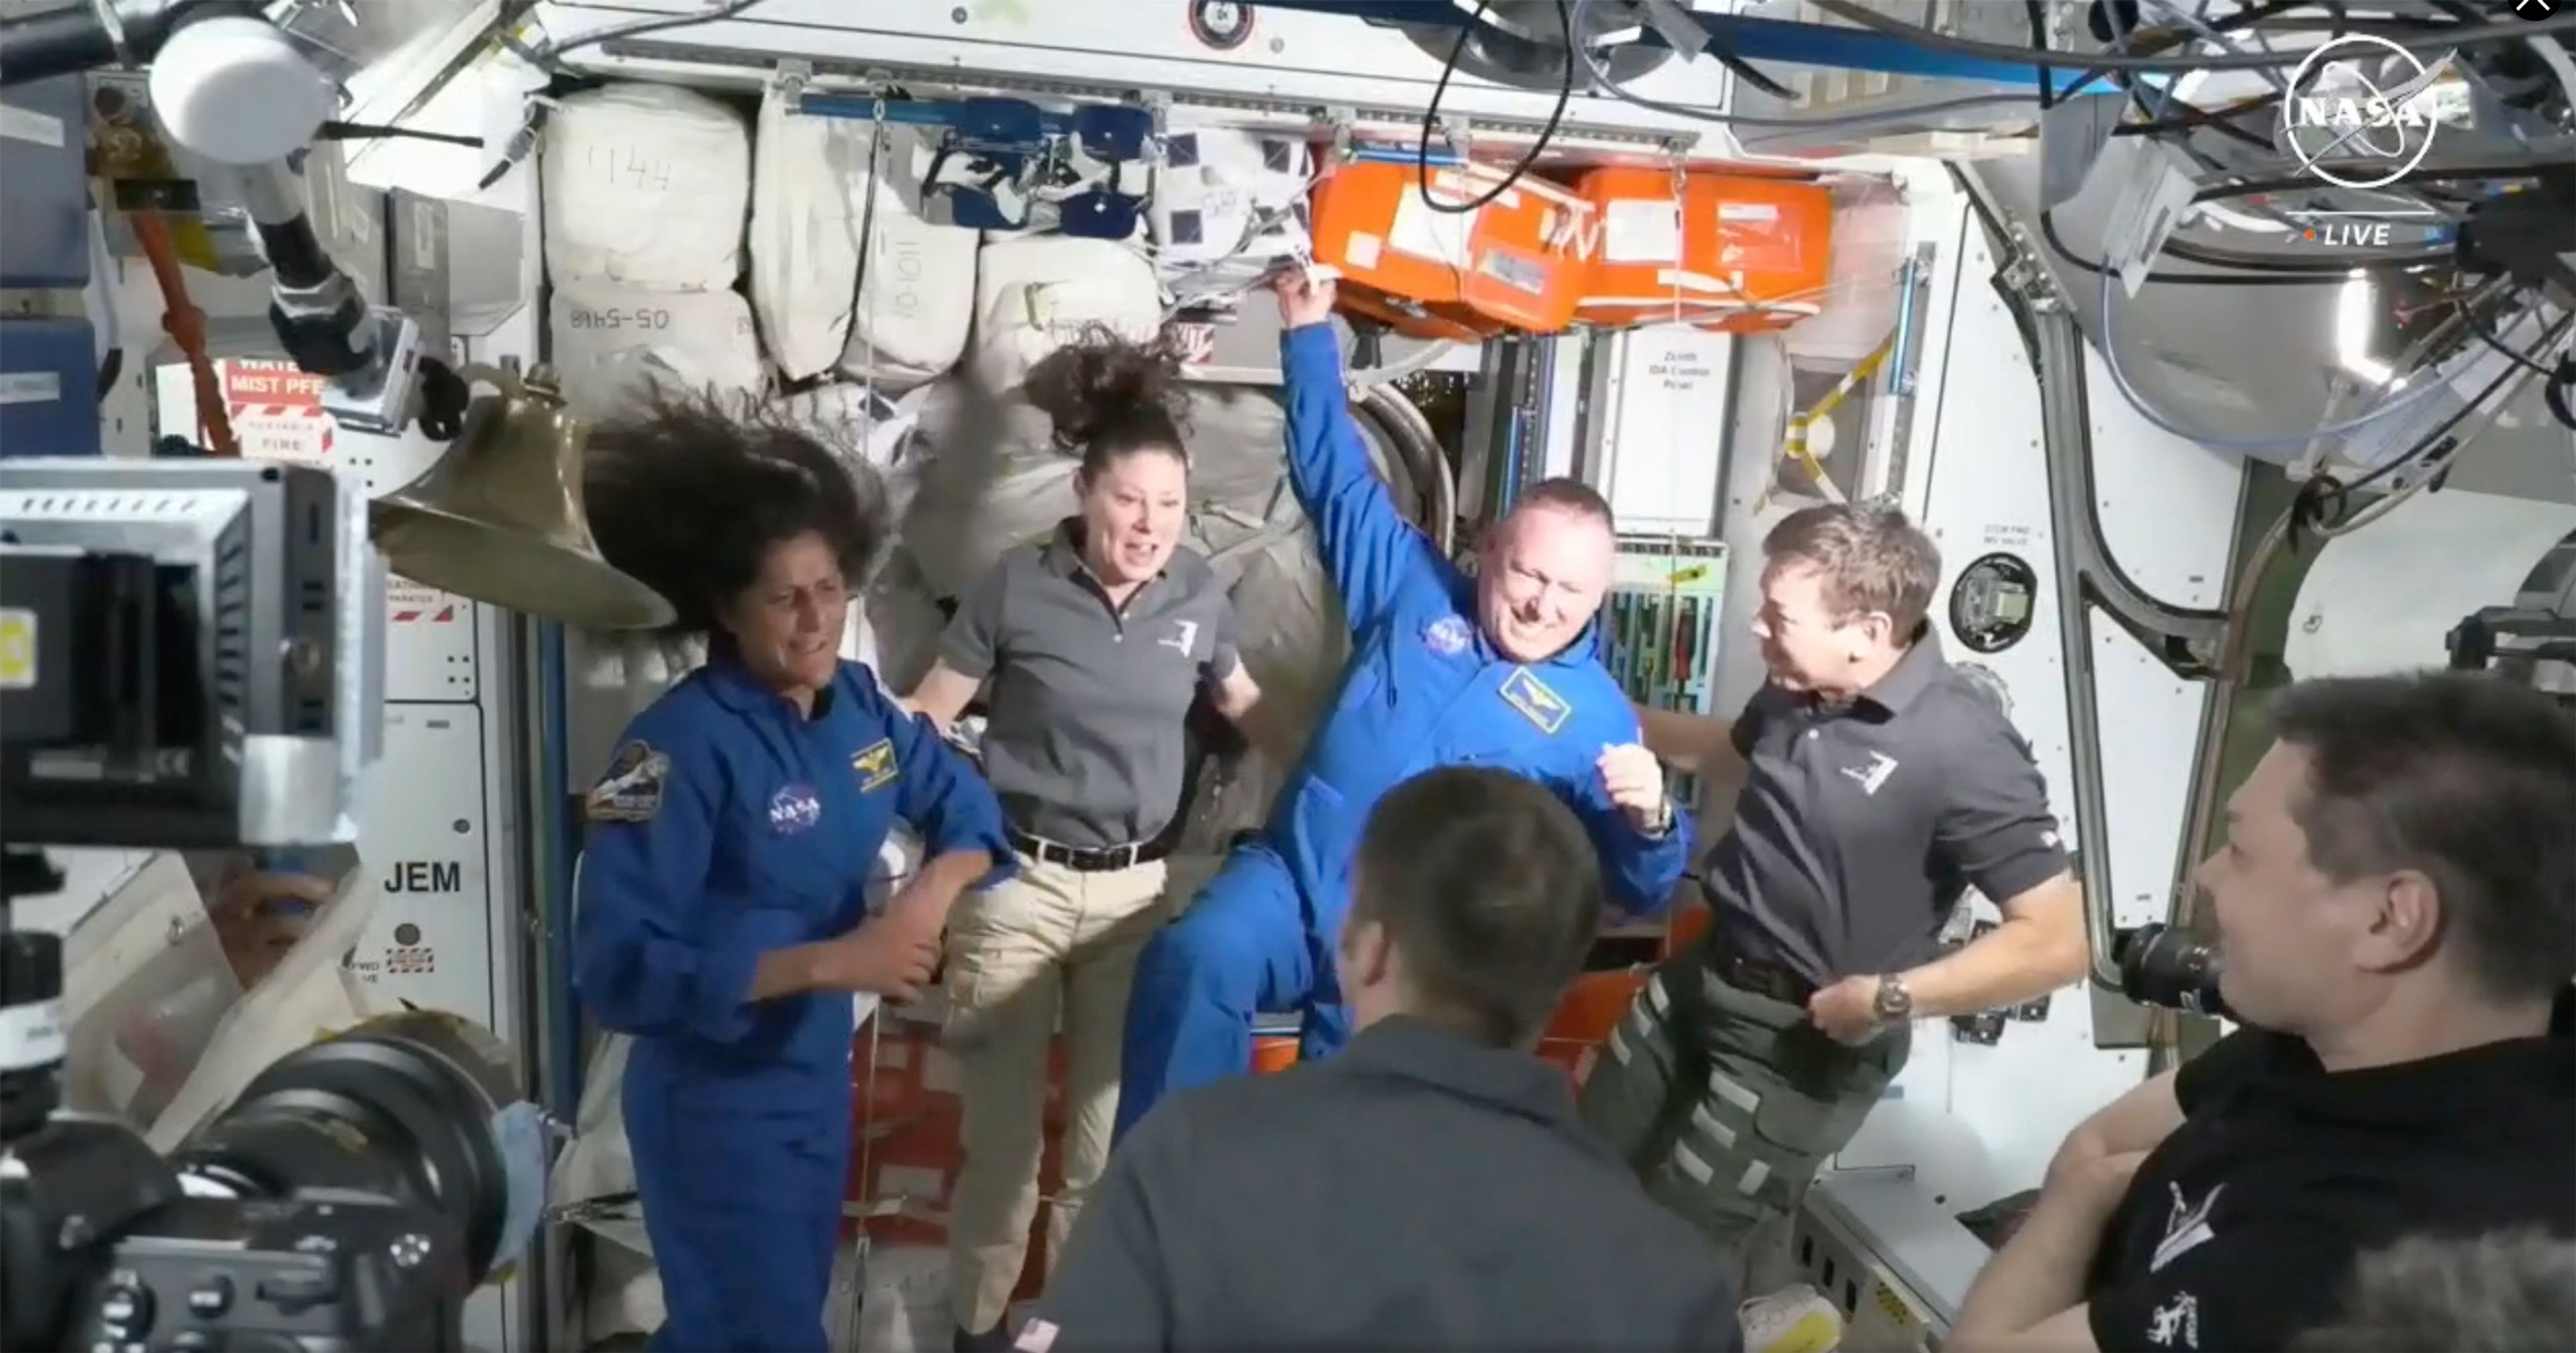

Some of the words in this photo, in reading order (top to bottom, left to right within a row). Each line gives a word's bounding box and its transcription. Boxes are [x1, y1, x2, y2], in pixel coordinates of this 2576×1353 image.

[570, 307, 669, 330] 05-5468
[239, 360, 300, 372] WATE
[231, 376, 280, 394] MIST
[262, 437, 301, 451] FIRE
[770, 798, 820, 824] NASA
[384, 861, 461, 893] JEM
